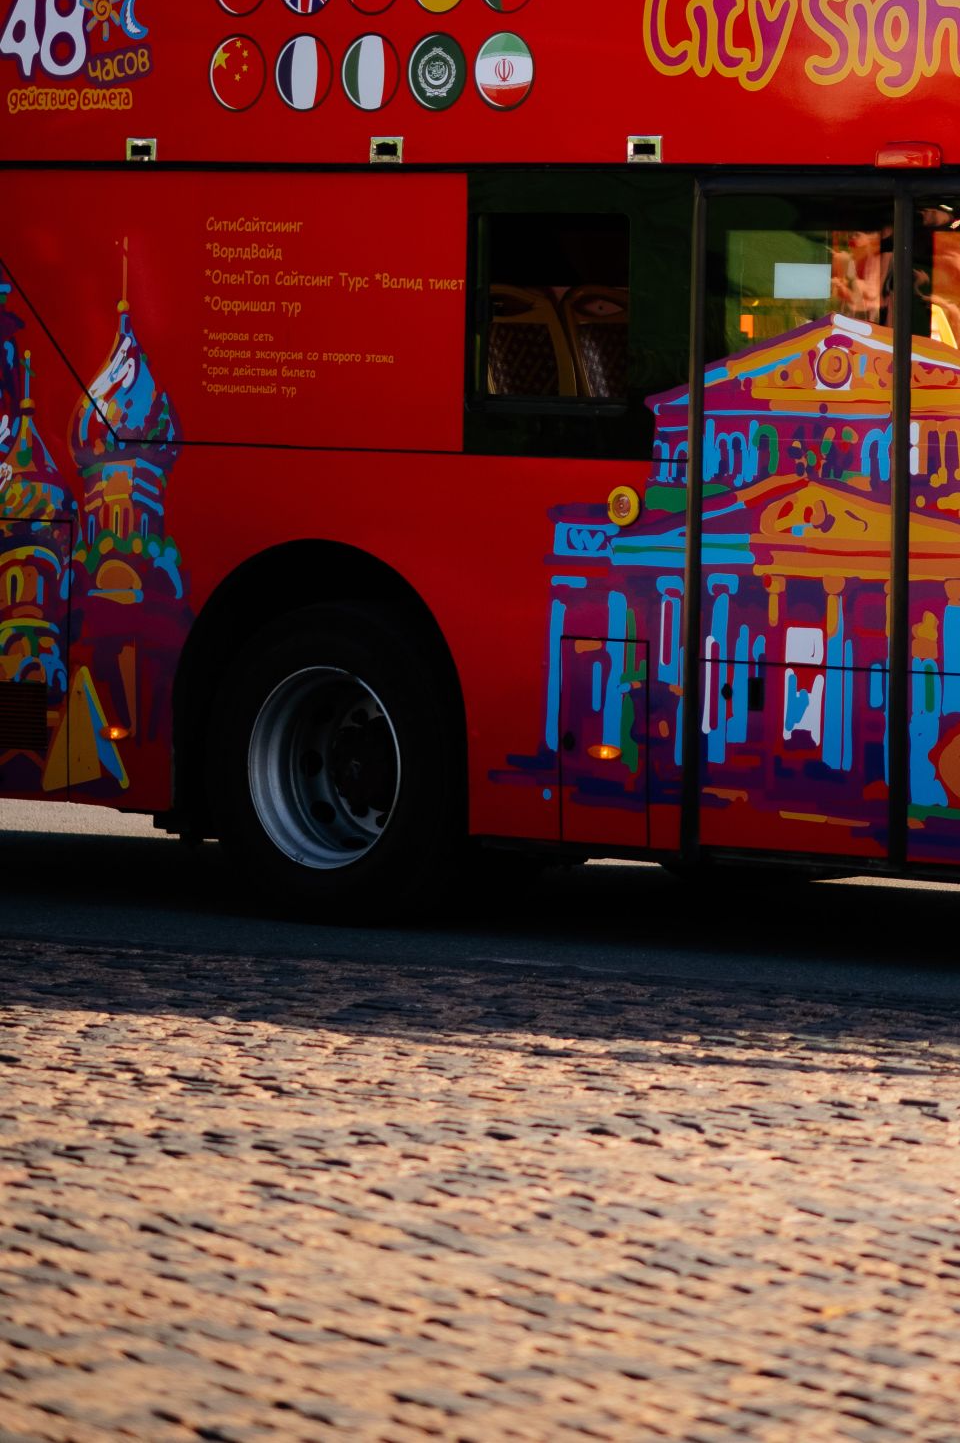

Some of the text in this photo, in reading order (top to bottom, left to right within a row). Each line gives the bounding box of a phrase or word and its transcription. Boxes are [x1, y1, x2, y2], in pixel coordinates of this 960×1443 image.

[88, 48, 150, 82] часов
[8, 86, 133, 114] действие билета
[206, 216, 303, 233] СитиСайтсиинг
[275, 270, 333, 287] Сайтсинг
[339, 272, 369, 292] Турс
[429, 278, 465, 291] тикет
[281, 300, 302, 317] тур
[253, 332, 274, 342] сеть
[255, 350, 303, 362] экскурсия
[307, 352, 319, 361] со
[322, 352, 361, 364] второго
[365, 353, 394, 364] этажа
[233, 365, 278, 378] действия
[281, 366, 316, 379] билета
[281, 385, 297, 398] тур
